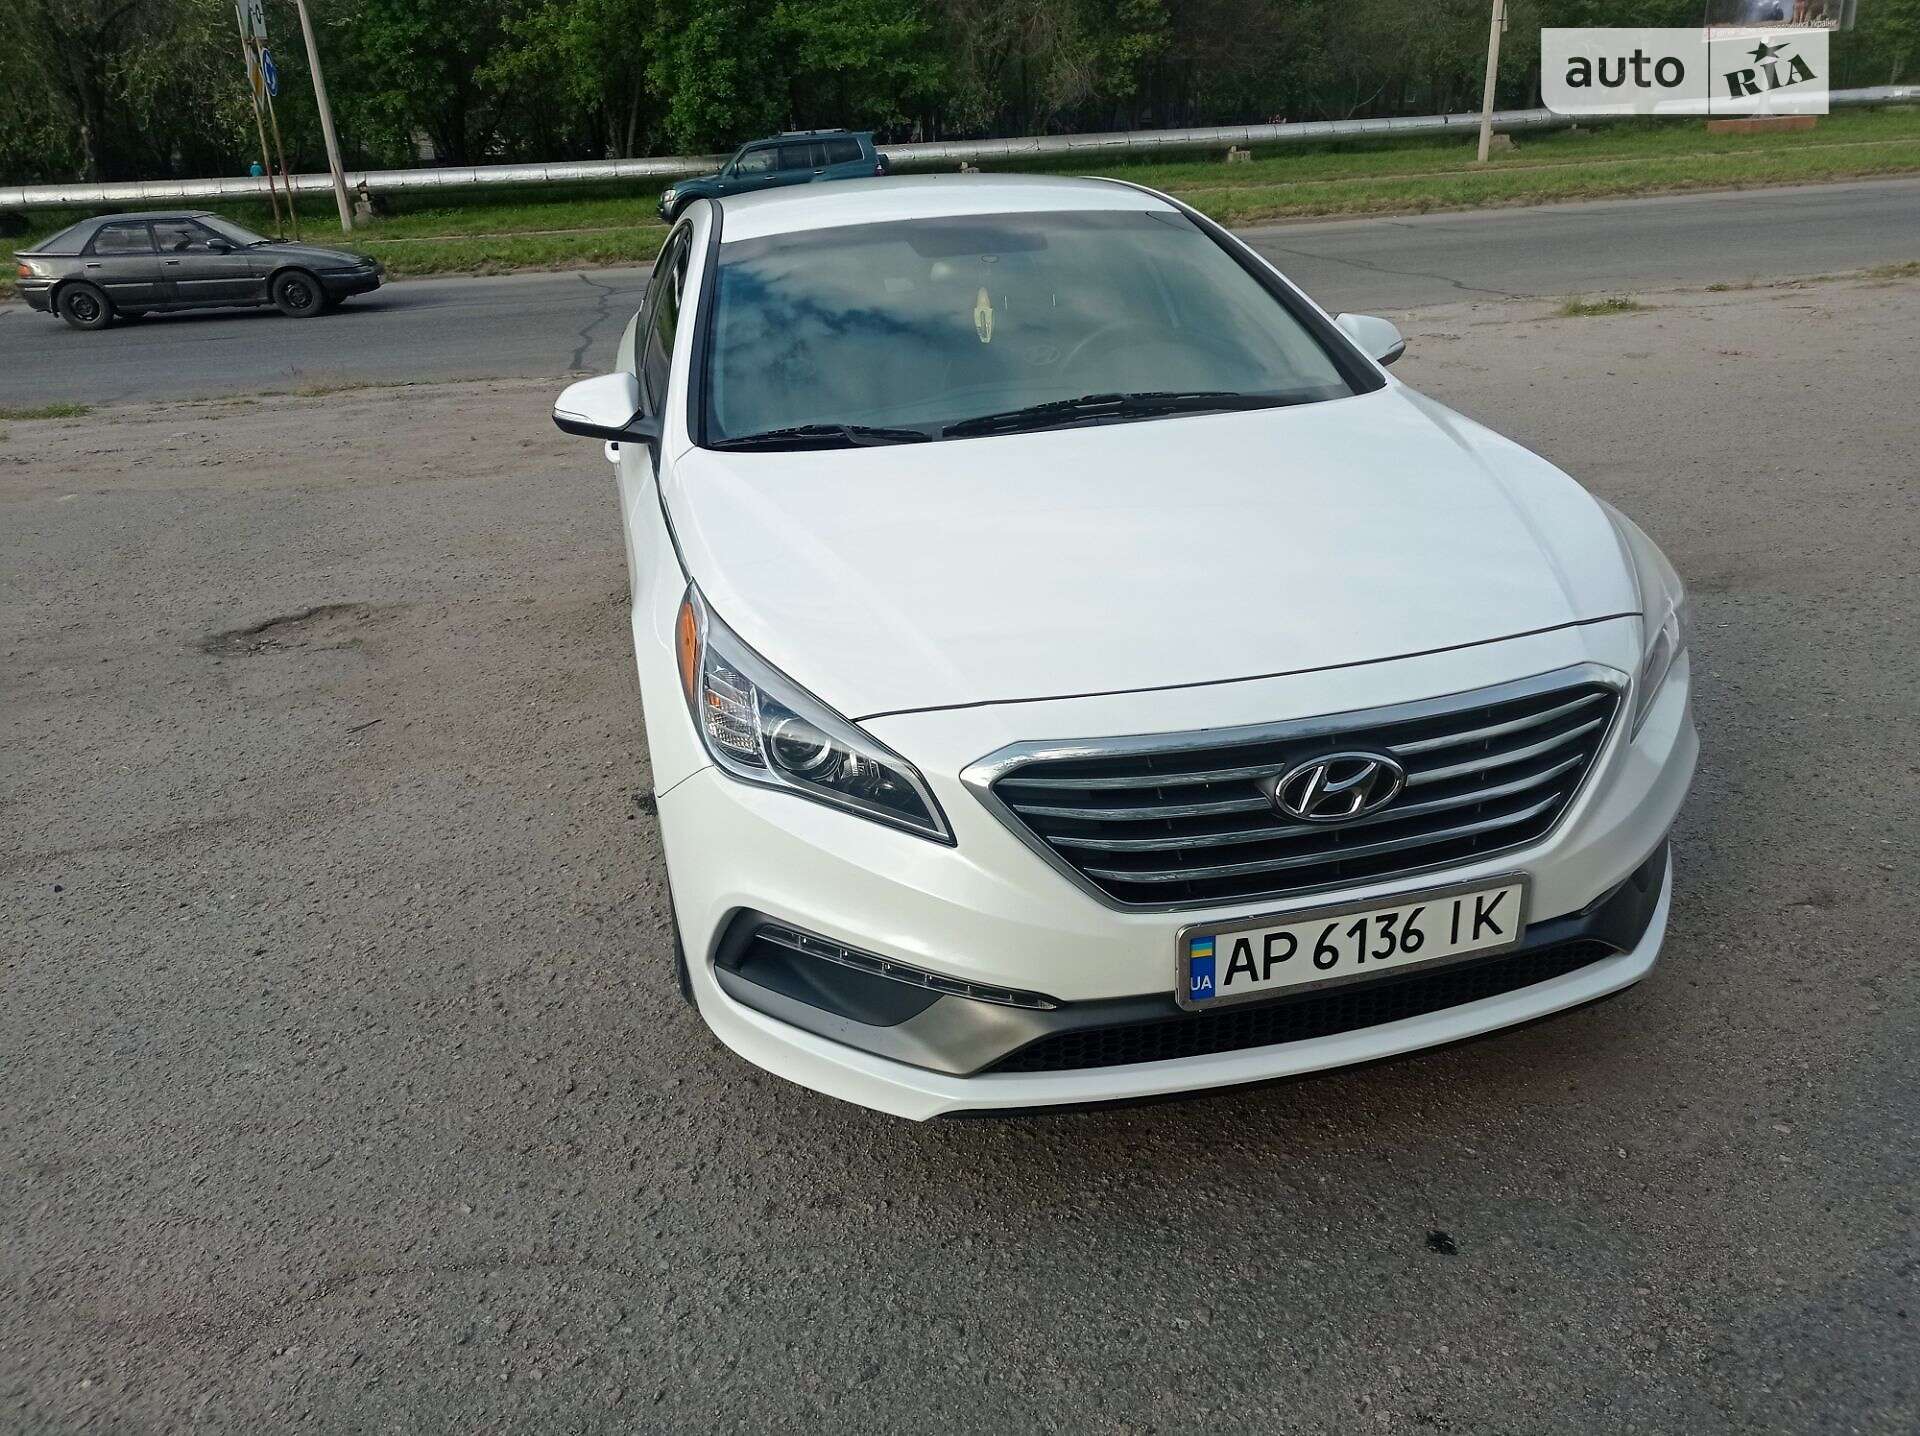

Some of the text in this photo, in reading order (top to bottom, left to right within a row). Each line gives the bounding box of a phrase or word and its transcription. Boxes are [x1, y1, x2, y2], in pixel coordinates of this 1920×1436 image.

[1223, 890, 1508, 986] AP 6136 IK
[1190, 976, 1212, 991] UA
